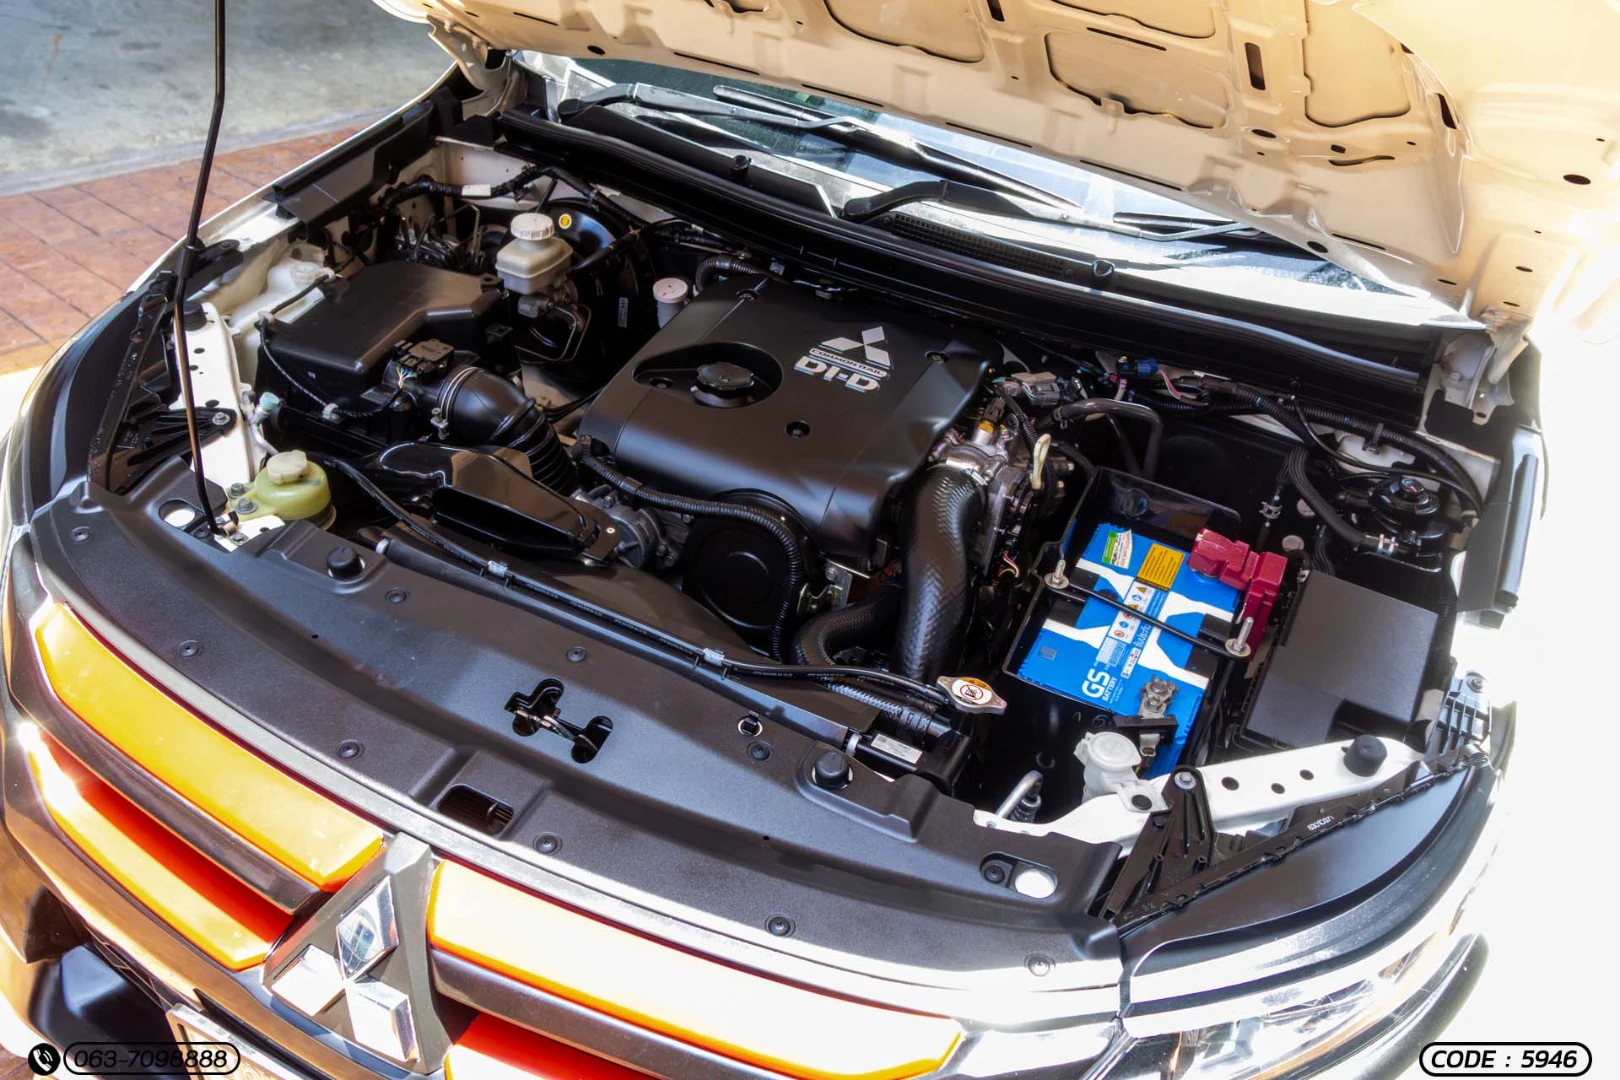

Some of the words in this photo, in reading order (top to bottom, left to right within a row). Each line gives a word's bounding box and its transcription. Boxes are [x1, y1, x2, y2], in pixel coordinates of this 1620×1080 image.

[794, 356, 880, 392] DI-D
[812, 349, 859, 367] COMMON
[859, 364, 883, 376] RAIL
[1082, 668, 1110, 698] GS
[1101, 676, 1117, 702] BATTERY
